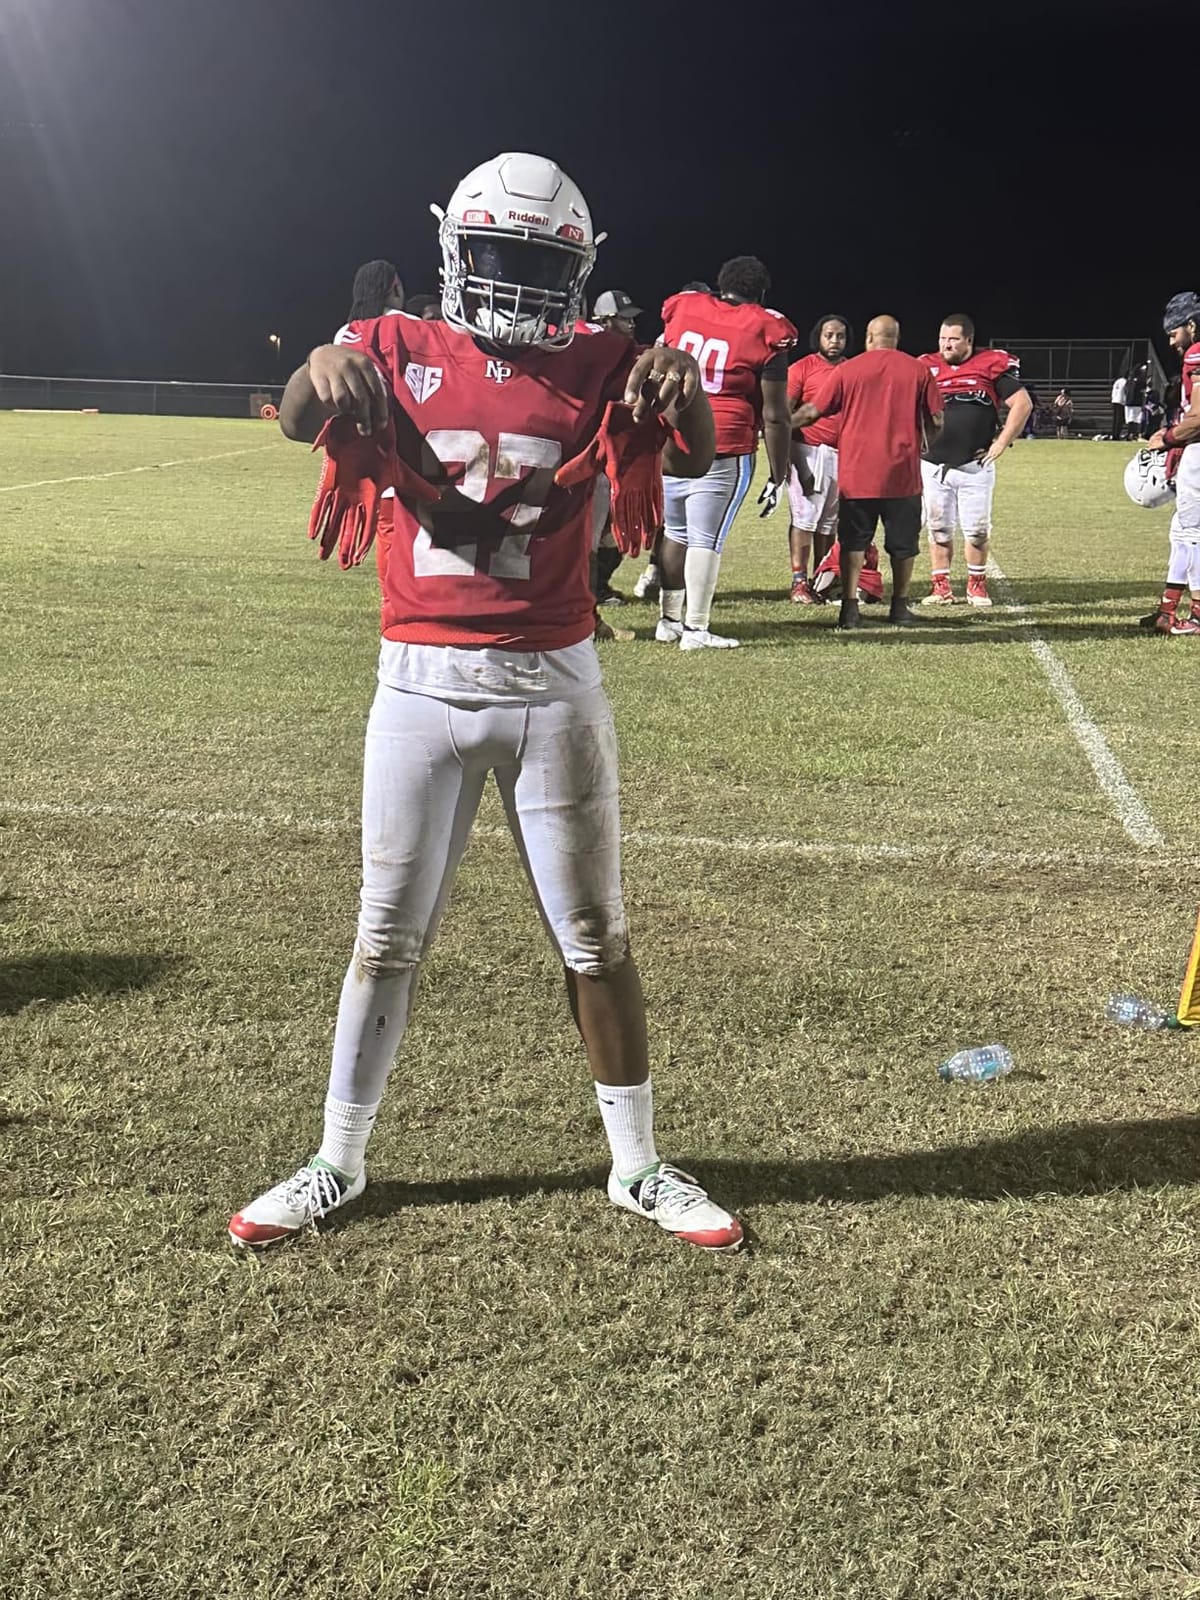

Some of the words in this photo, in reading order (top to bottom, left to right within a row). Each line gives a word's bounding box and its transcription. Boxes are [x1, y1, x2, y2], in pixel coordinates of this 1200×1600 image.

[508, 210, 549, 227] Riddell
[404, 362, 443, 404] SG
[485, 360, 512, 383] NP
[413, 429, 563, 580] 27
